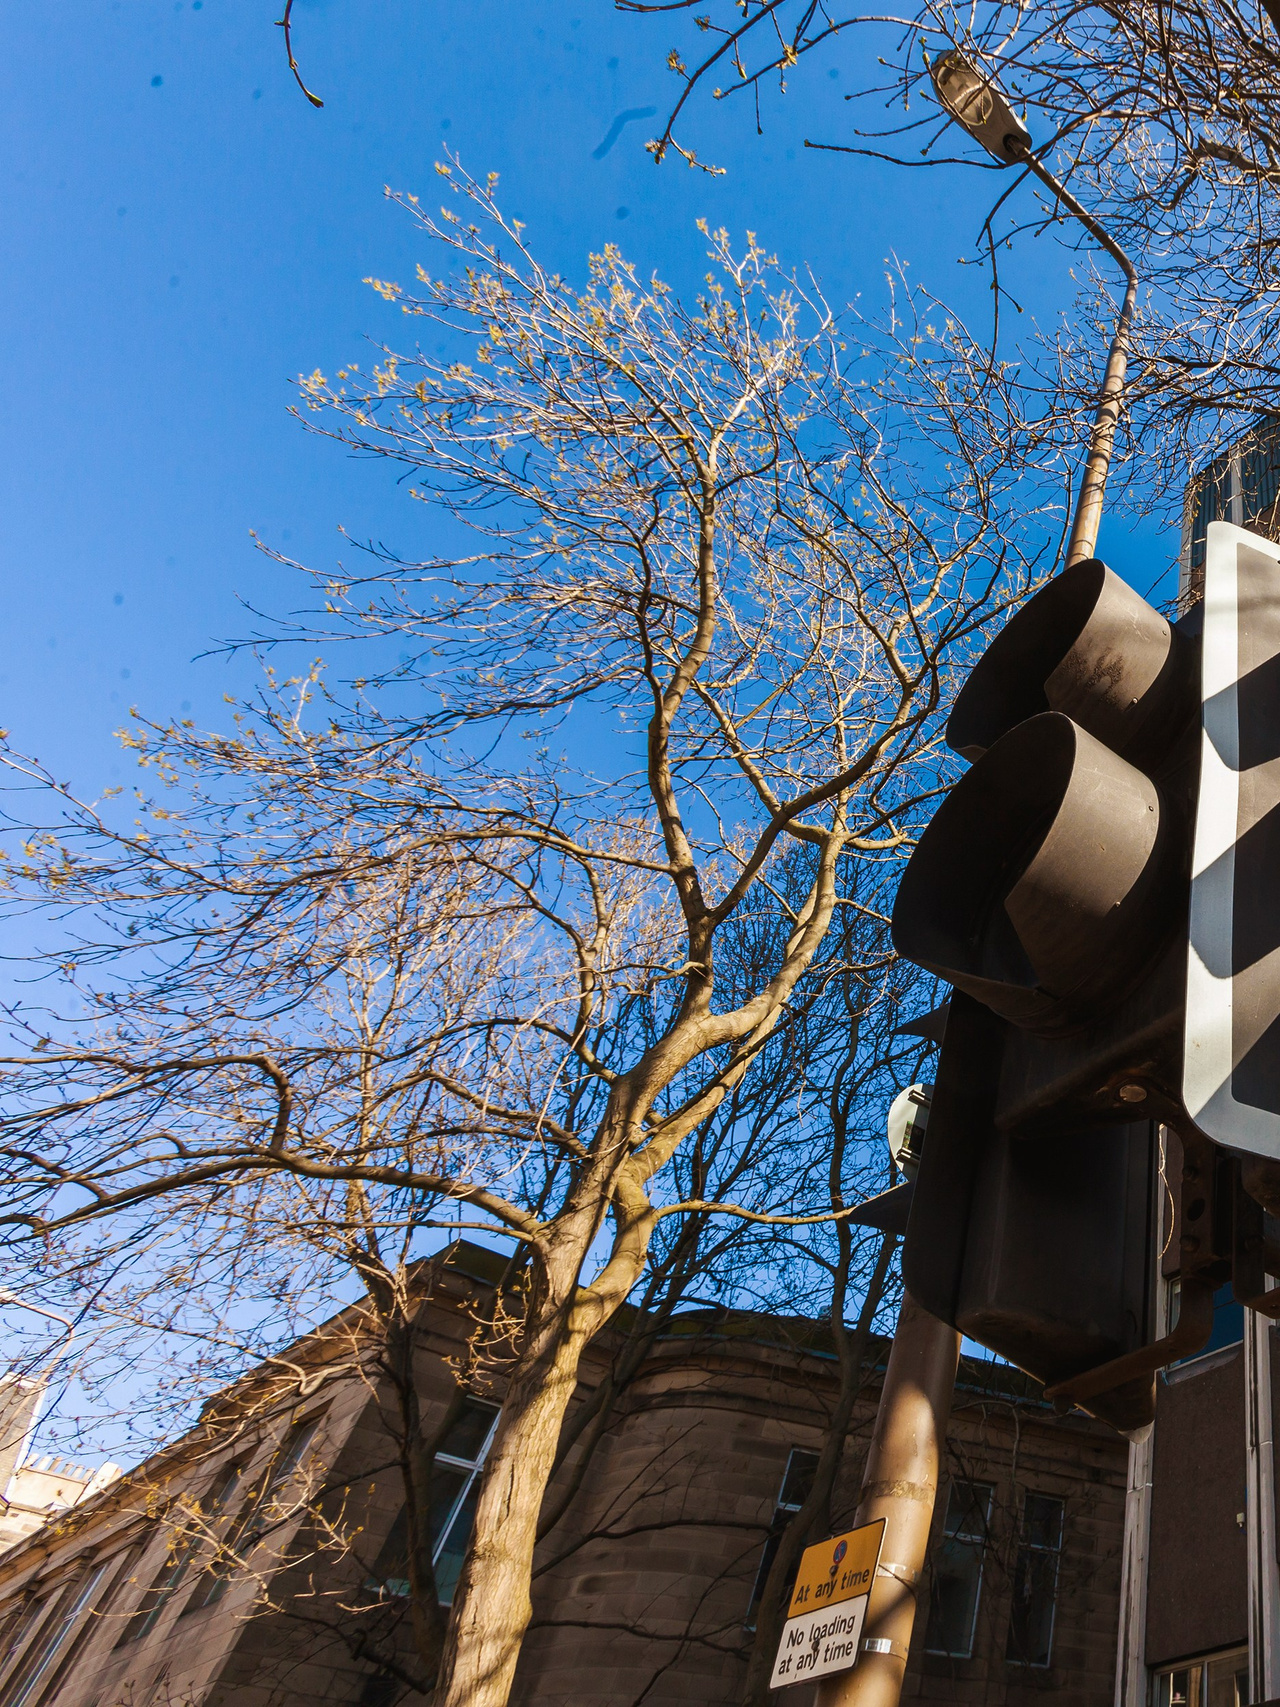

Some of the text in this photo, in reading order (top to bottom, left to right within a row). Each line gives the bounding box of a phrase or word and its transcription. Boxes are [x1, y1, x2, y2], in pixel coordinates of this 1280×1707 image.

[795, 1568, 870, 1604] At any time
[787, 1615, 855, 1648] No loading
[778, 1640, 853, 1675] at any time
